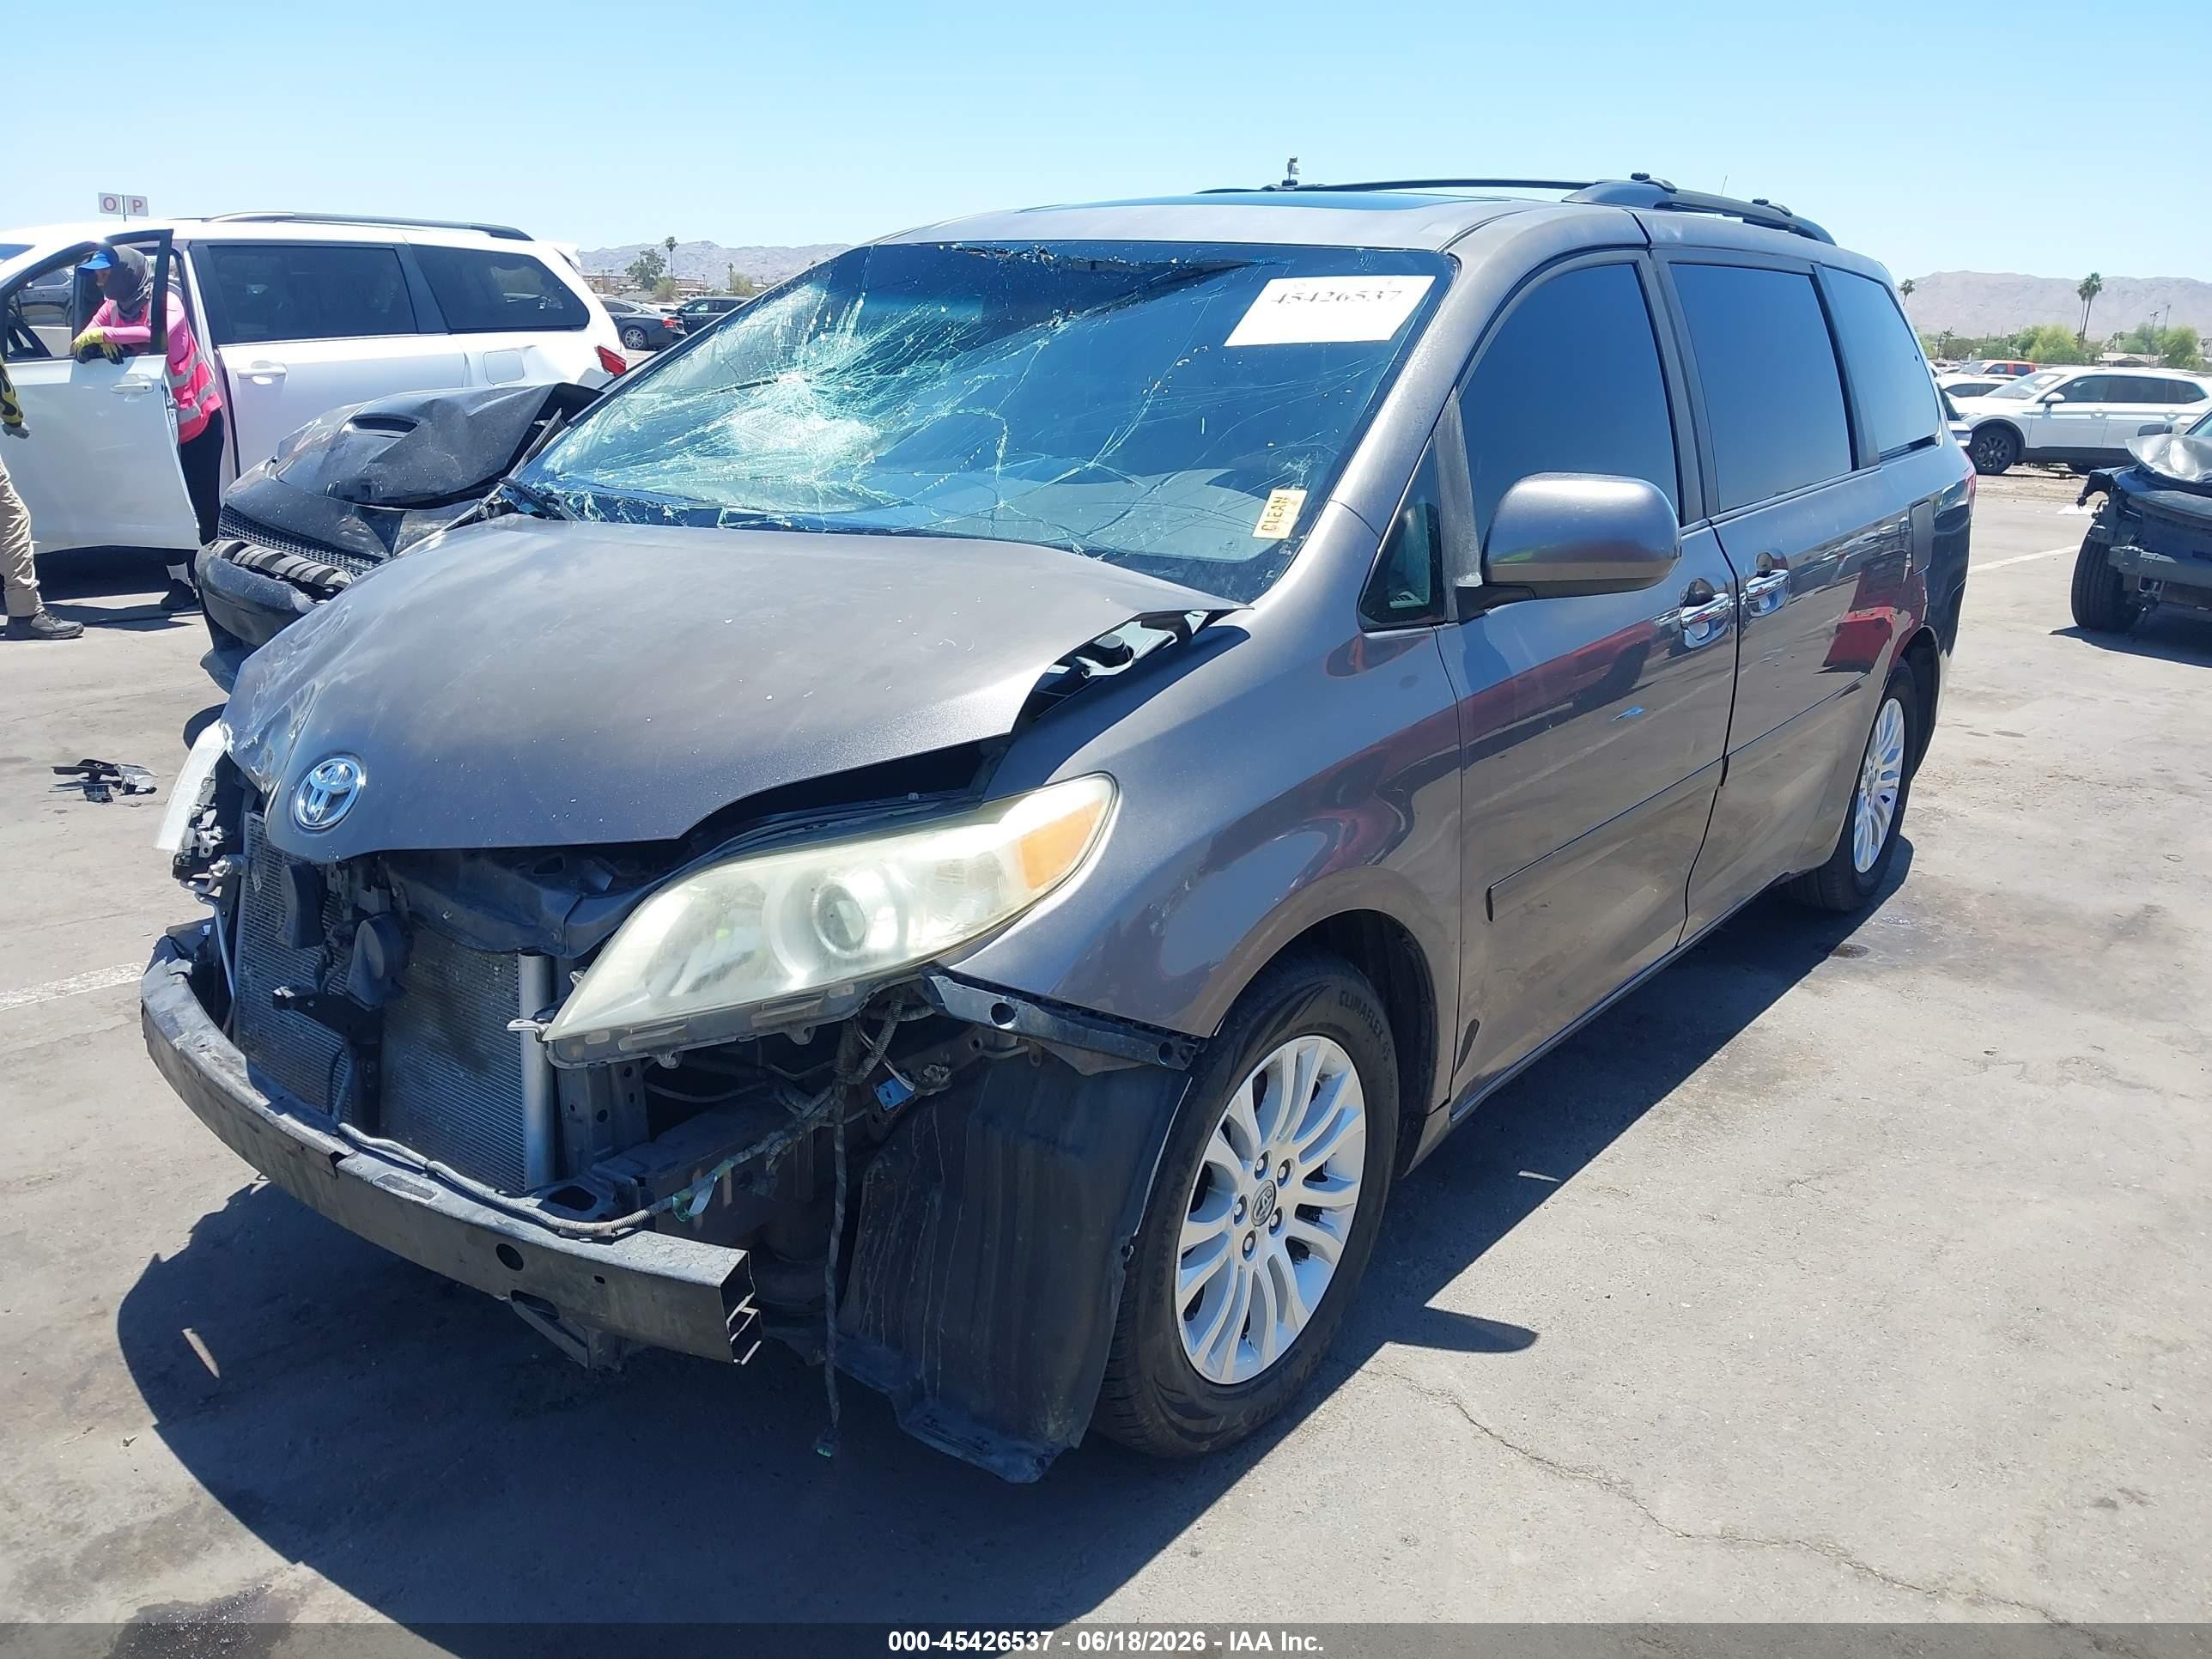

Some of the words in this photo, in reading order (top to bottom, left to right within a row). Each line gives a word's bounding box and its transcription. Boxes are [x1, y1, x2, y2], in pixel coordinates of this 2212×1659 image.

[103, 197, 117, 211] O
[132, 199, 143, 213] P
[1271, 290, 1402, 304] 45426537
[1261, 496, 1288, 531] CLEAN
